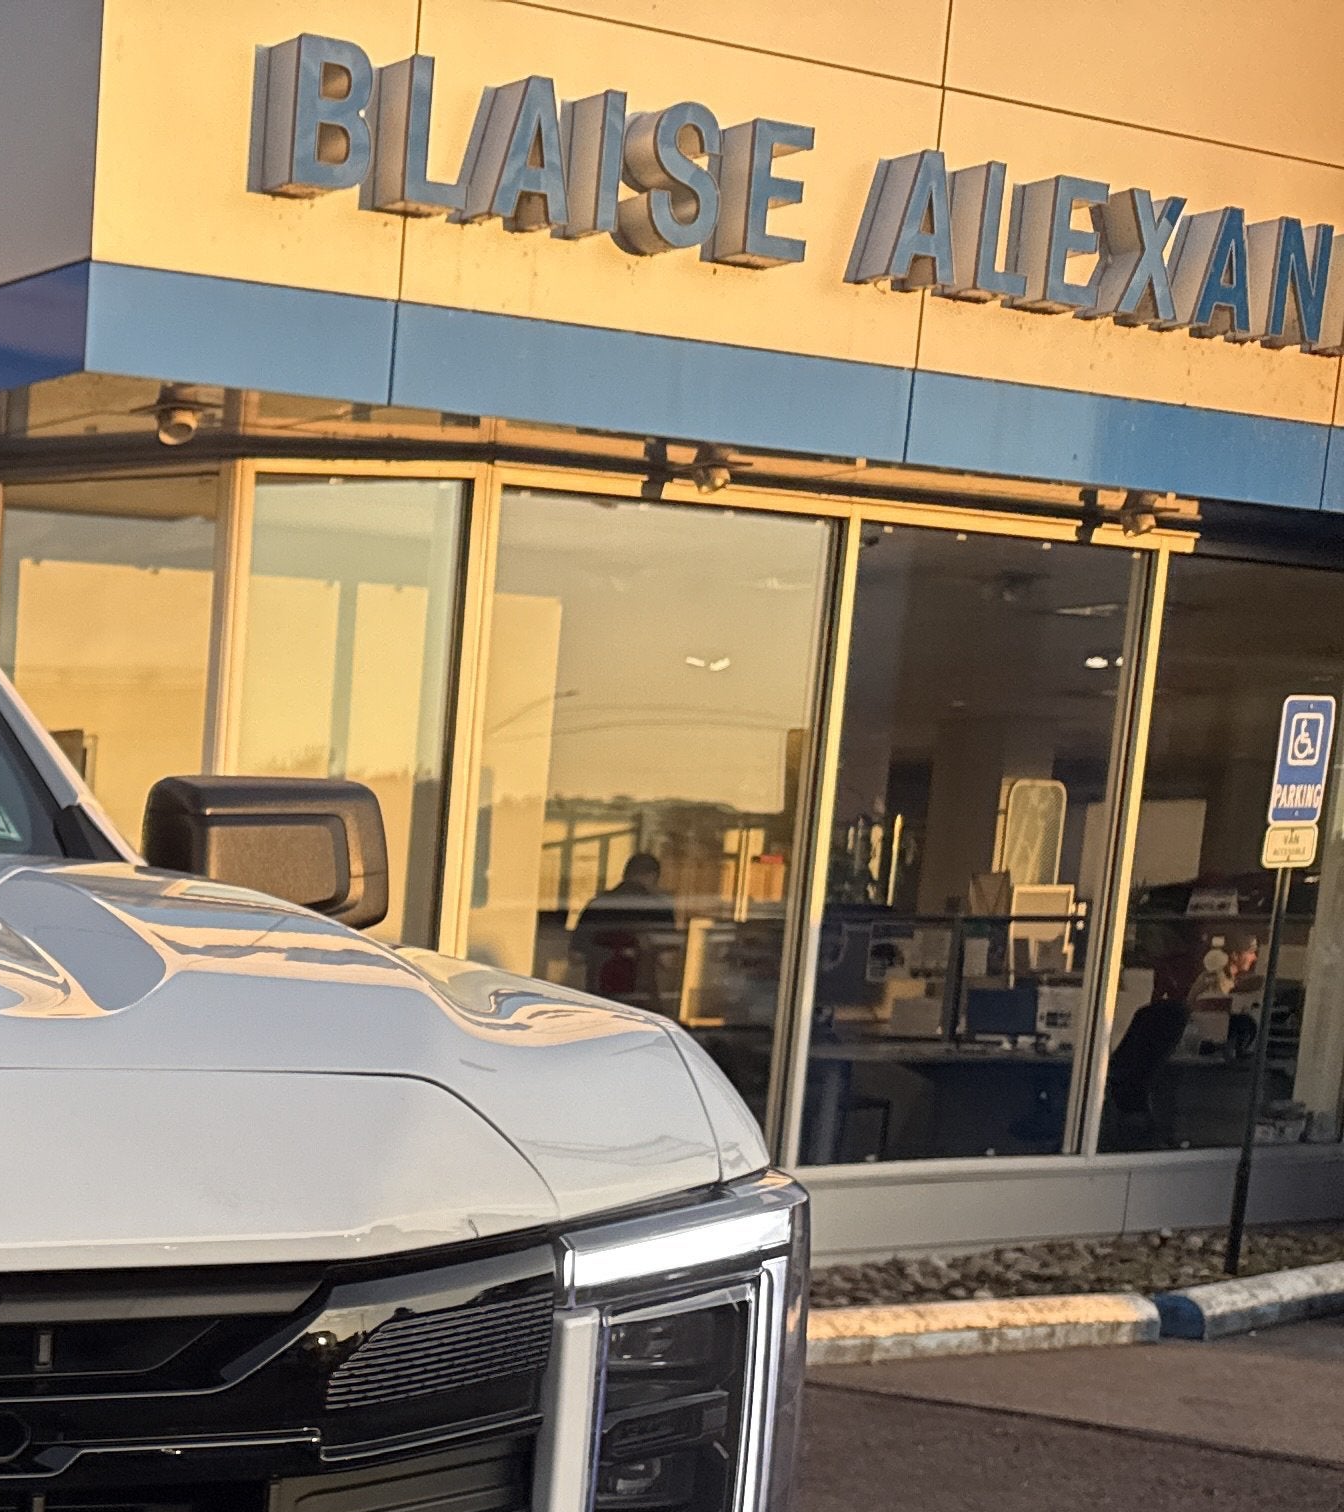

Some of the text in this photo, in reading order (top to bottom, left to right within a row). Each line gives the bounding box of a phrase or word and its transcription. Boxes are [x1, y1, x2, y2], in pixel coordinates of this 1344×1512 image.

[250, 33, 816, 270] BLAISE
[1273, 784, 1323, 808] PARKING
[1283, 834, 1300, 845] VAN
